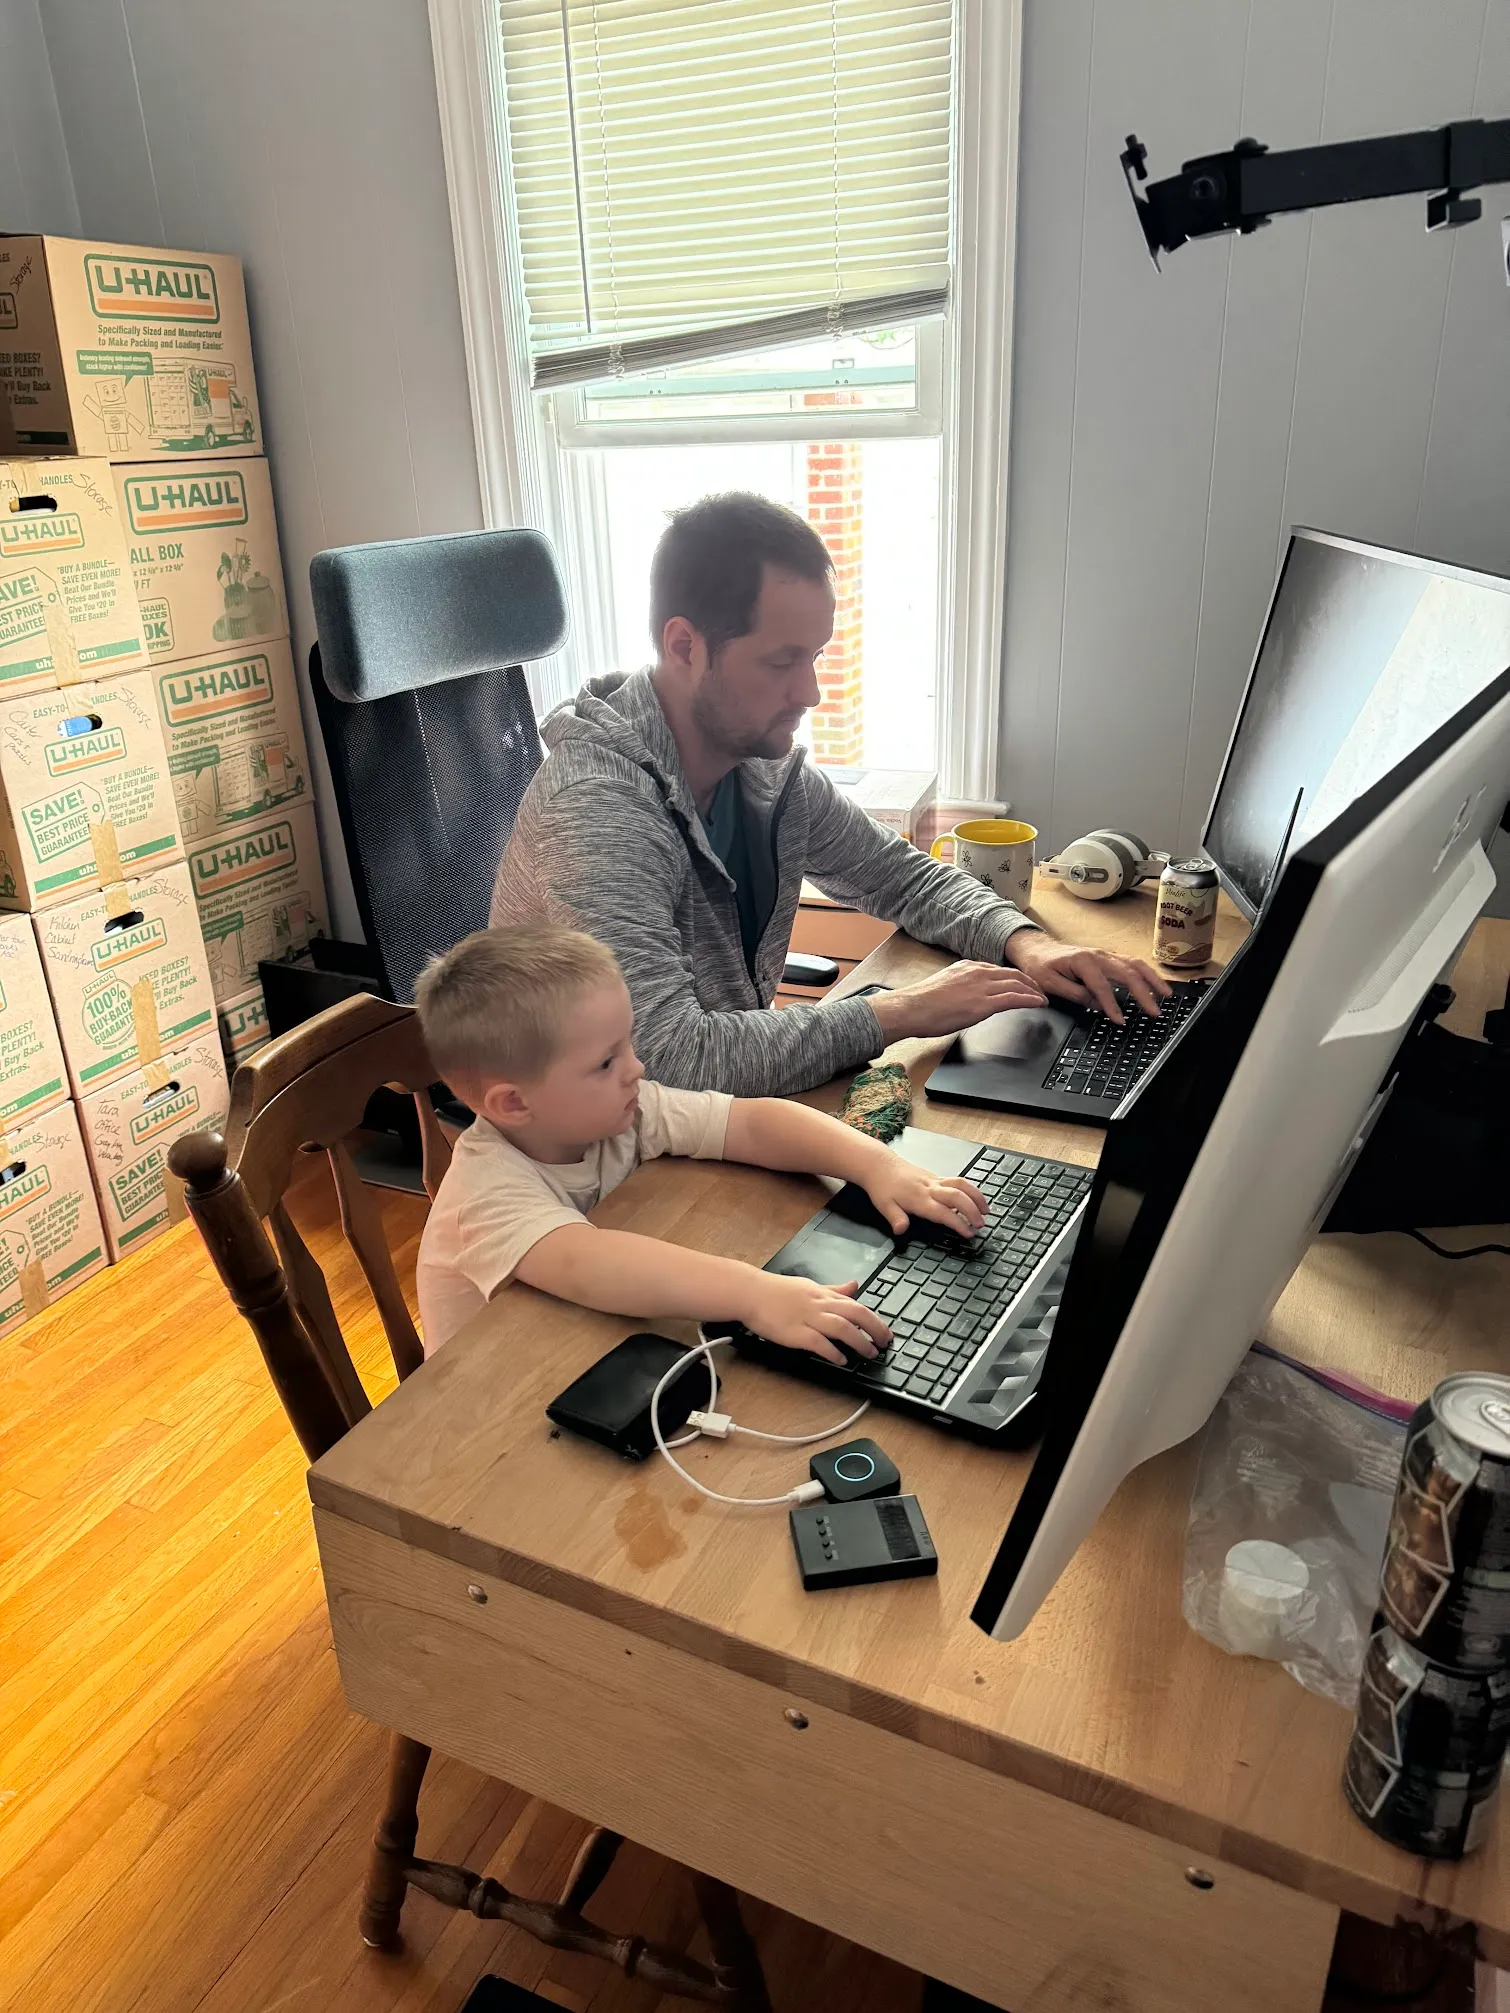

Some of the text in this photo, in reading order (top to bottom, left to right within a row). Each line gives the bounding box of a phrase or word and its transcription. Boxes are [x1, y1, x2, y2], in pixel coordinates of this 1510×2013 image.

[94, 265, 211, 300] U-HAUL
[98, 324, 222, 339] Specifically Sized and Manufactured
[98, 337, 106, 346] to
[108, 337, 129, 347] Make
[130, 338, 159, 349] Packing
[160, 339, 173, 348] and
[175, 339, 201, 351] Loading
[14, 353, 41, 365] BOXES?
[14, 366, 44, 378] PLENTY!
[134, 480, 239, 512] U-HAUL
[0, 519, 78, 543] U-HAUL
[130, 543, 184, 564] ALL BOX
[61, 568, 121, 585] SAVE EVEN MORE!
[64, 579, 115, 594] Beat Our Bundle
[141, 578, 151, 589] FT
[0, 575, 40, 604] AVE!
[66, 594, 86, 605] Prices
[88, 592, 100, 601] and
[68, 604, 82, 614] Give
[84, 602, 96, 611] You
[70, 609, 109, 624] FREE Boxes!
[140, 603, 167, 613] -HAUL
[141, 611, 168, 621] OXES
[168, 664, 265, 706] U-HAUL
[90, 691, 118, 706] ANDLES
[50, 733, 121, 763] U-HAUL
[105, 771, 160, 795] SAVE EVEN MORE!
[107, 792, 121, 803] Beat
[122, 790, 133, 799] Our
[109, 801, 128, 813] Prices
[128, 797, 139, 807] and
[30, 789, 85, 826] SAVE!
[124, 808, 135, 818] You
[128, 811, 148, 825] Boxes!
[36, 812, 90, 845] BEST PRICE
[41, 826, 92, 857] GUARANTEE
[197, 831, 289, 879] U-HAUL
[1175, 903, 1193, 917] BEER
[1160, 915, 1186, 929] SODA
[96, 923, 162, 960] U-HAUL
[161, 956, 189, 976] BOXES?
[161, 966, 191, 987] PLENTY!
[84, 973, 114, 995] U-HAUL
[163, 985, 177, 998] Buy
[179, 975, 198, 990] Back
[86, 983, 127, 1020] 100%
[159, 994, 185, 1011] Extras.
[0, 1020, 34, 1043] BOXES?
[94, 1012, 136, 1046] GUARANTE
[4, 1041, 45, 1069] Buy Back
[168, 1056, 192, 1075] ANDLES
[0, 1062, 30, 1083] Extras.
[134, 1093, 195, 1133] U-HAUL
[115, 1148, 164, 1191] SAVE!
[0, 1173, 45, 1210] HAUL
[121, 1171, 163, 1206] BEST PRIC
[30, 1217, 46, 1233] SAVE
[47, 1206, 64, 1222] EVEN
